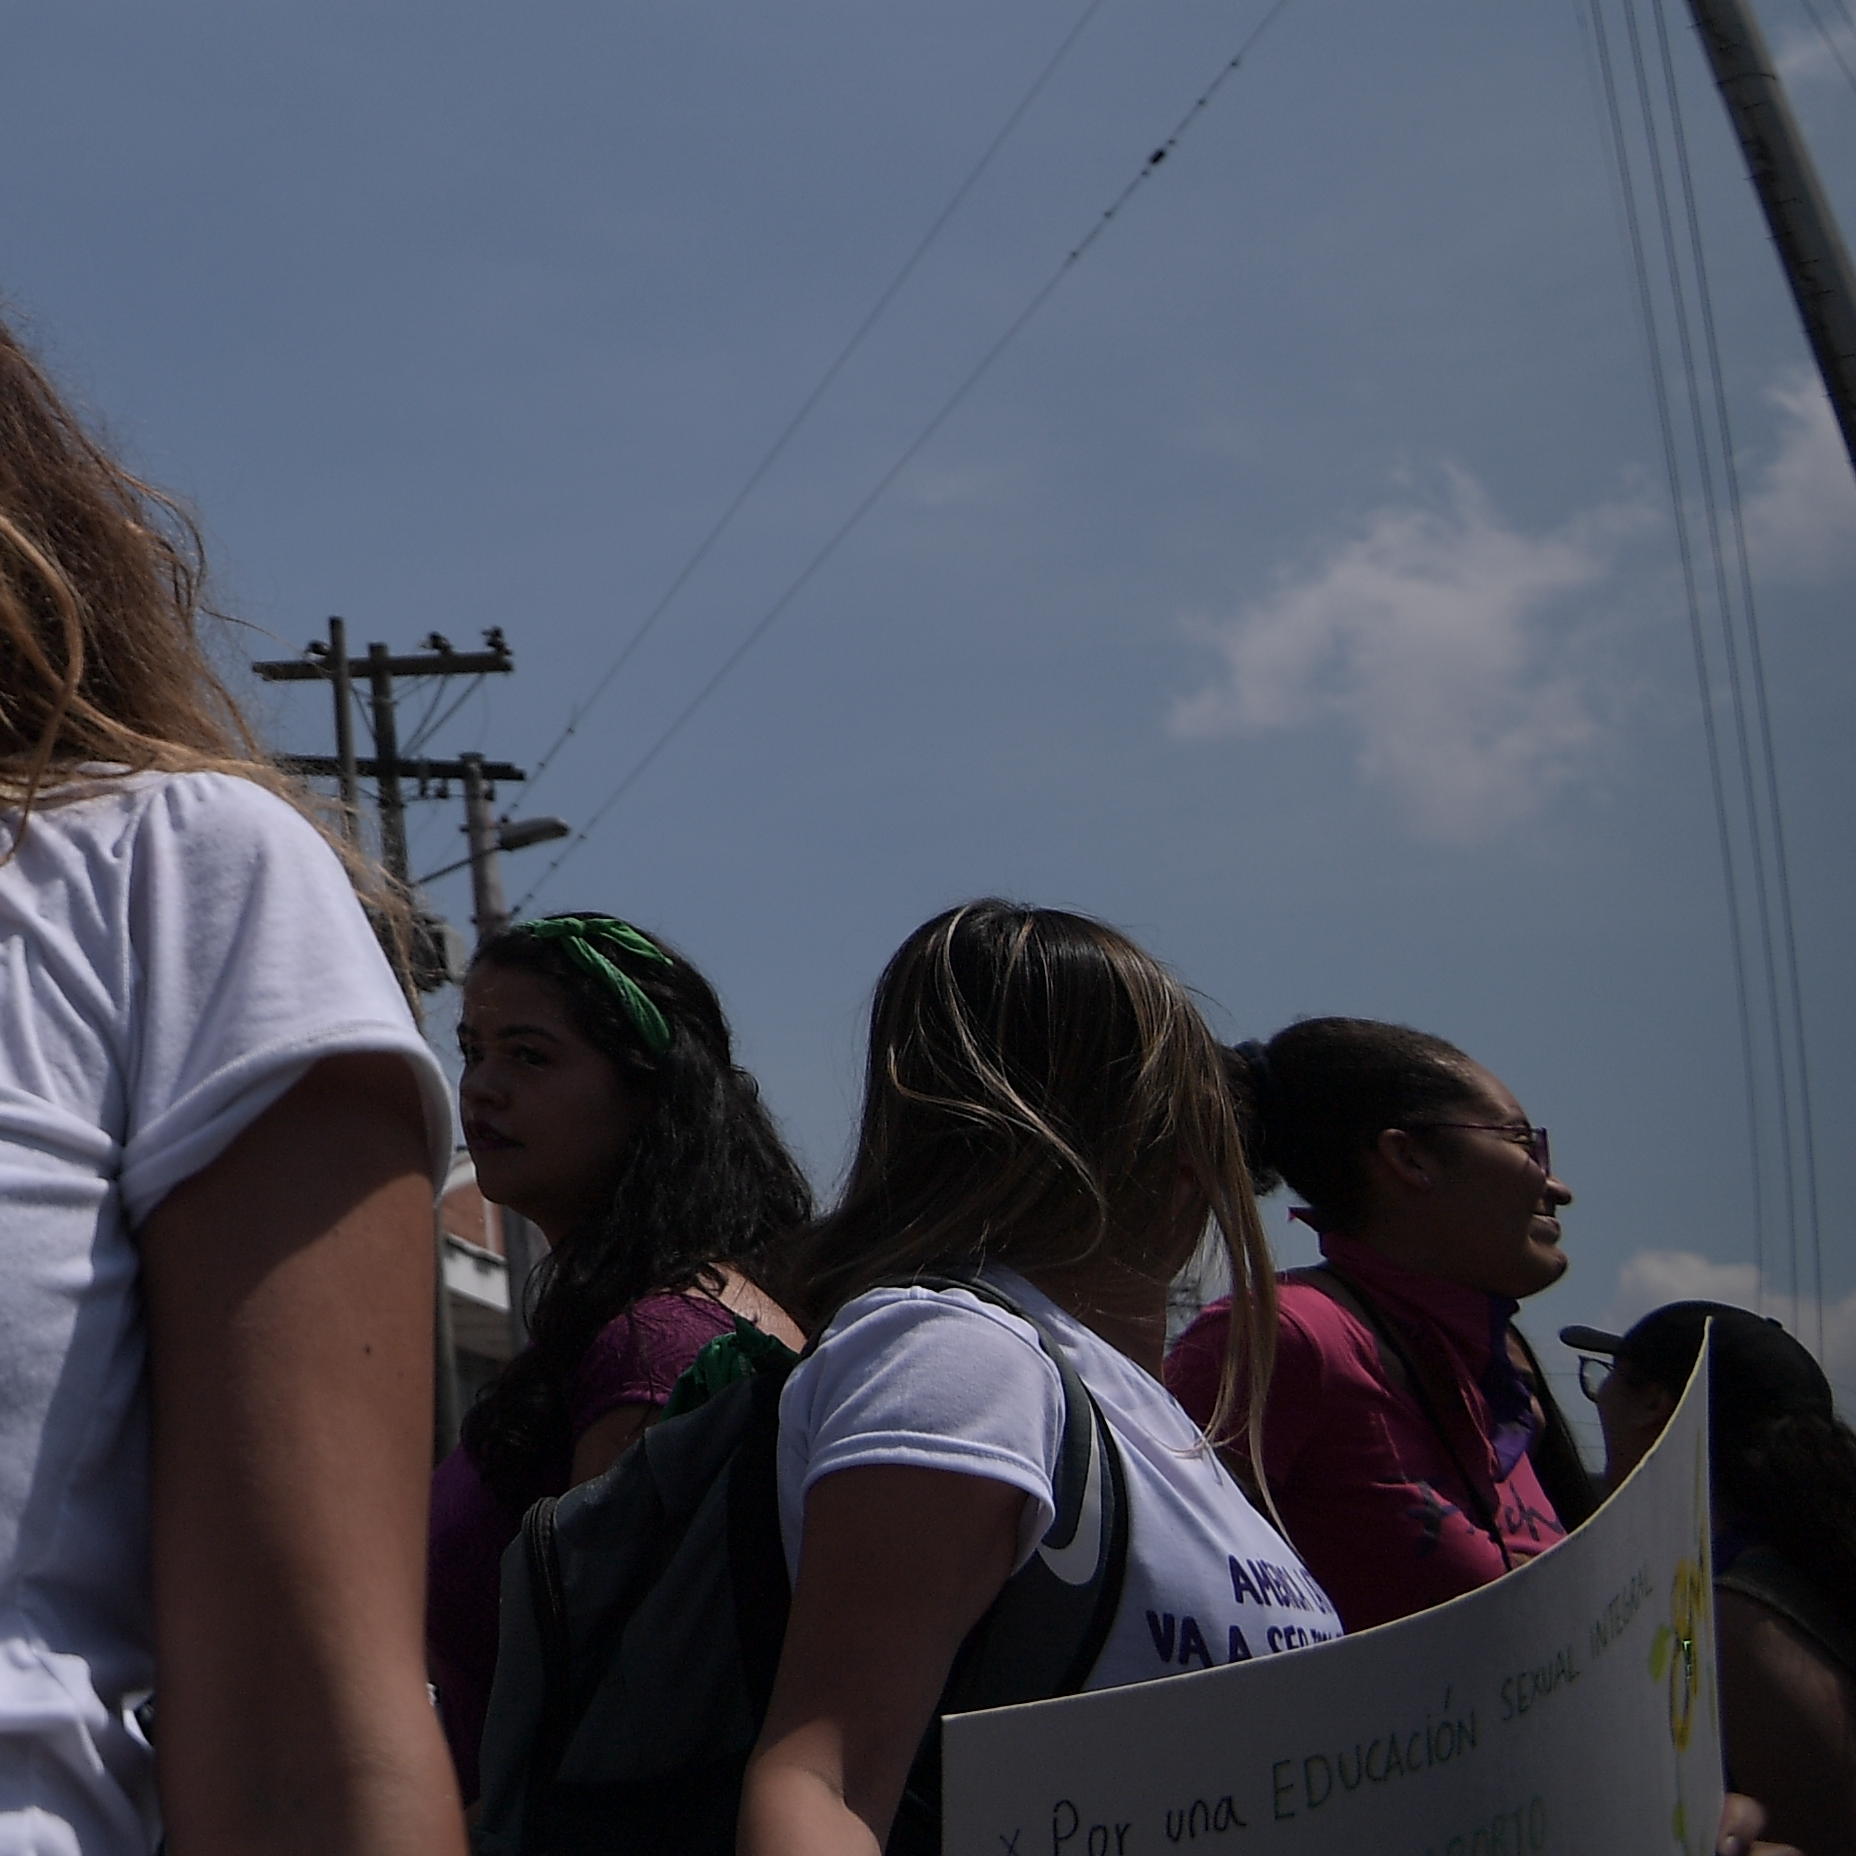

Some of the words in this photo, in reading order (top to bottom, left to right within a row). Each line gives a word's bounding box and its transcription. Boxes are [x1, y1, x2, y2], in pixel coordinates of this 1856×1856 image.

[1146, 1610, 1214, 1669] VA
[1053, 1800, 1132, 1856] Por
[1167, 1795, 1247, 1842] una
[1272, 1685, 1477, 1820] EDUCACIÓN
[1500, 1647, 1581, 1723] SEXUAL
